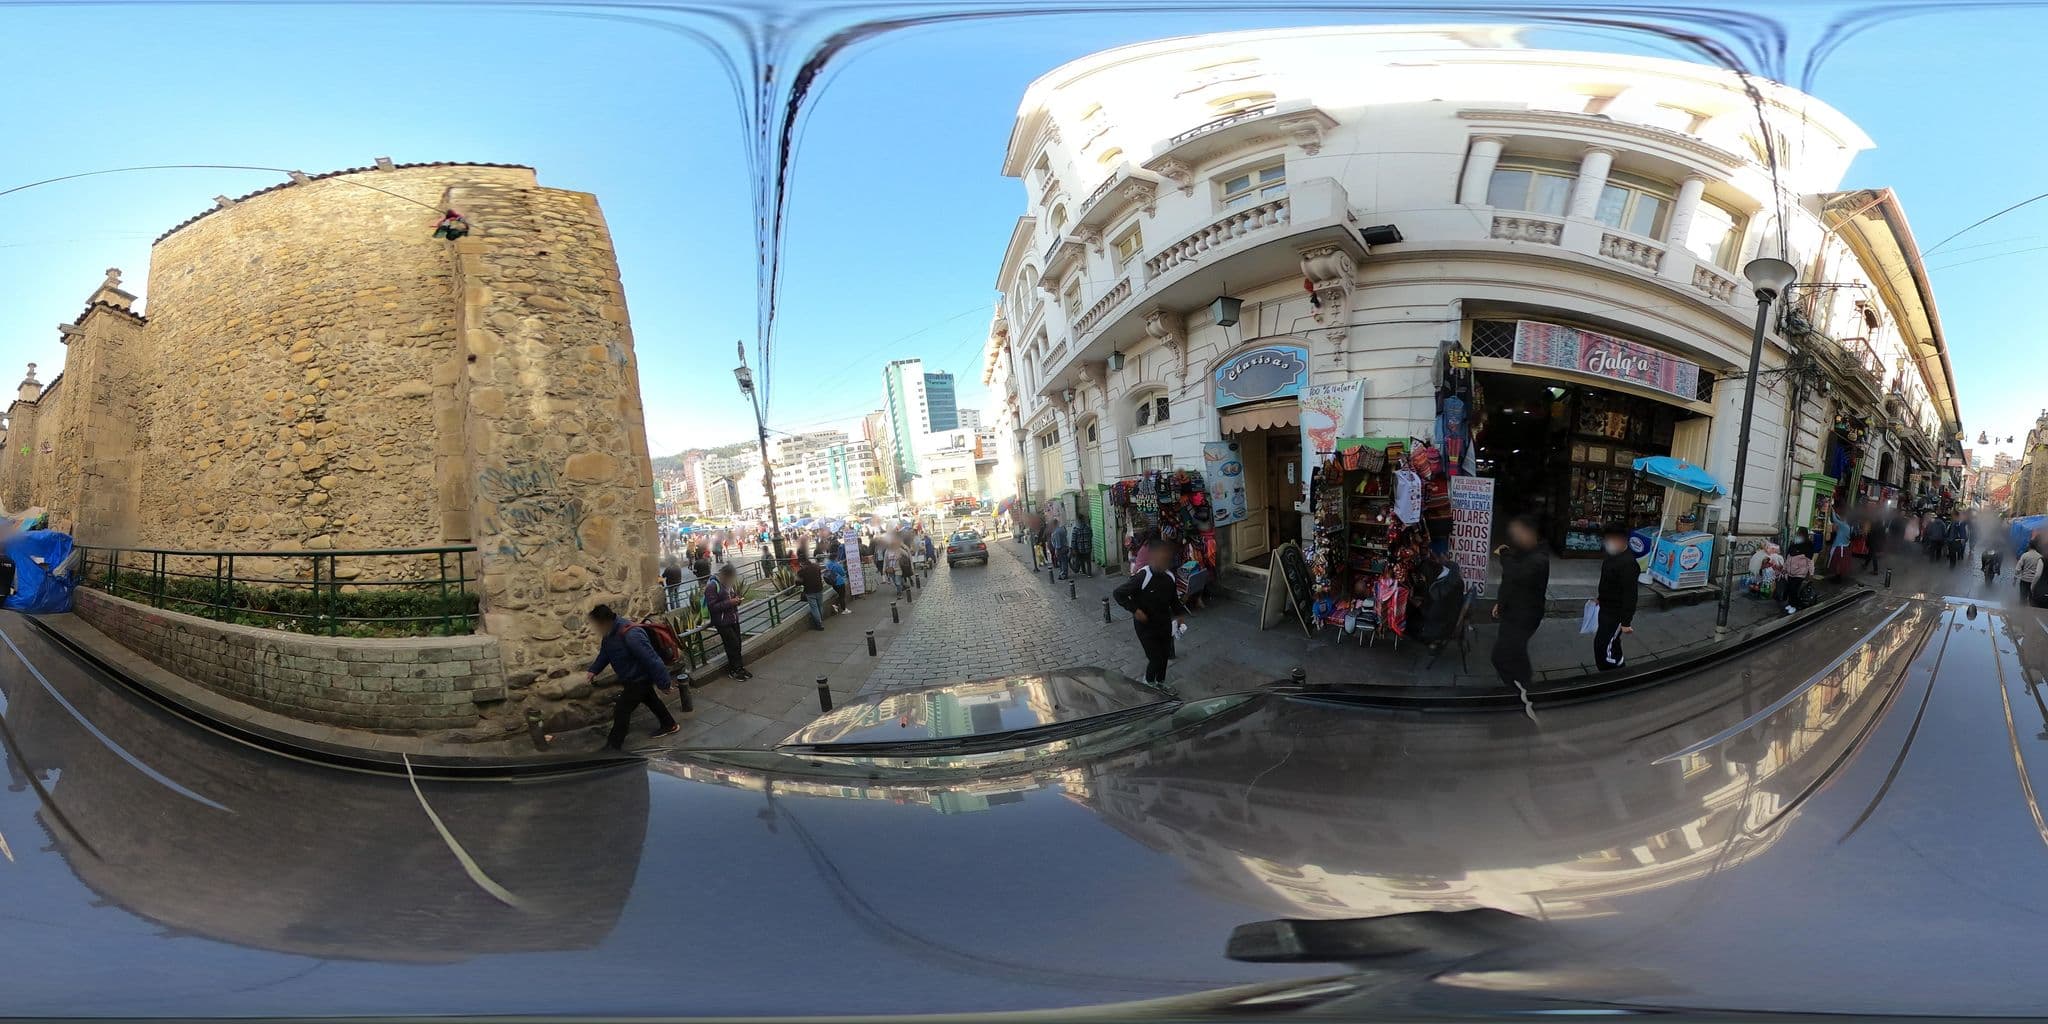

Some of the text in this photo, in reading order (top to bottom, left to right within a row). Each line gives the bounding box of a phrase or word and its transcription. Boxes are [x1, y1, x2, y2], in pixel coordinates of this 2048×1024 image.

[1228, 355, 1289, 380] Clarisas
[1589, 350, 1650, 375] Jalq'a
[1472, 500, 1490, 510] VENTA
[1452, 509, 1489, 525] DOLARES
[1451, 523, 1488, 539] EUROS
